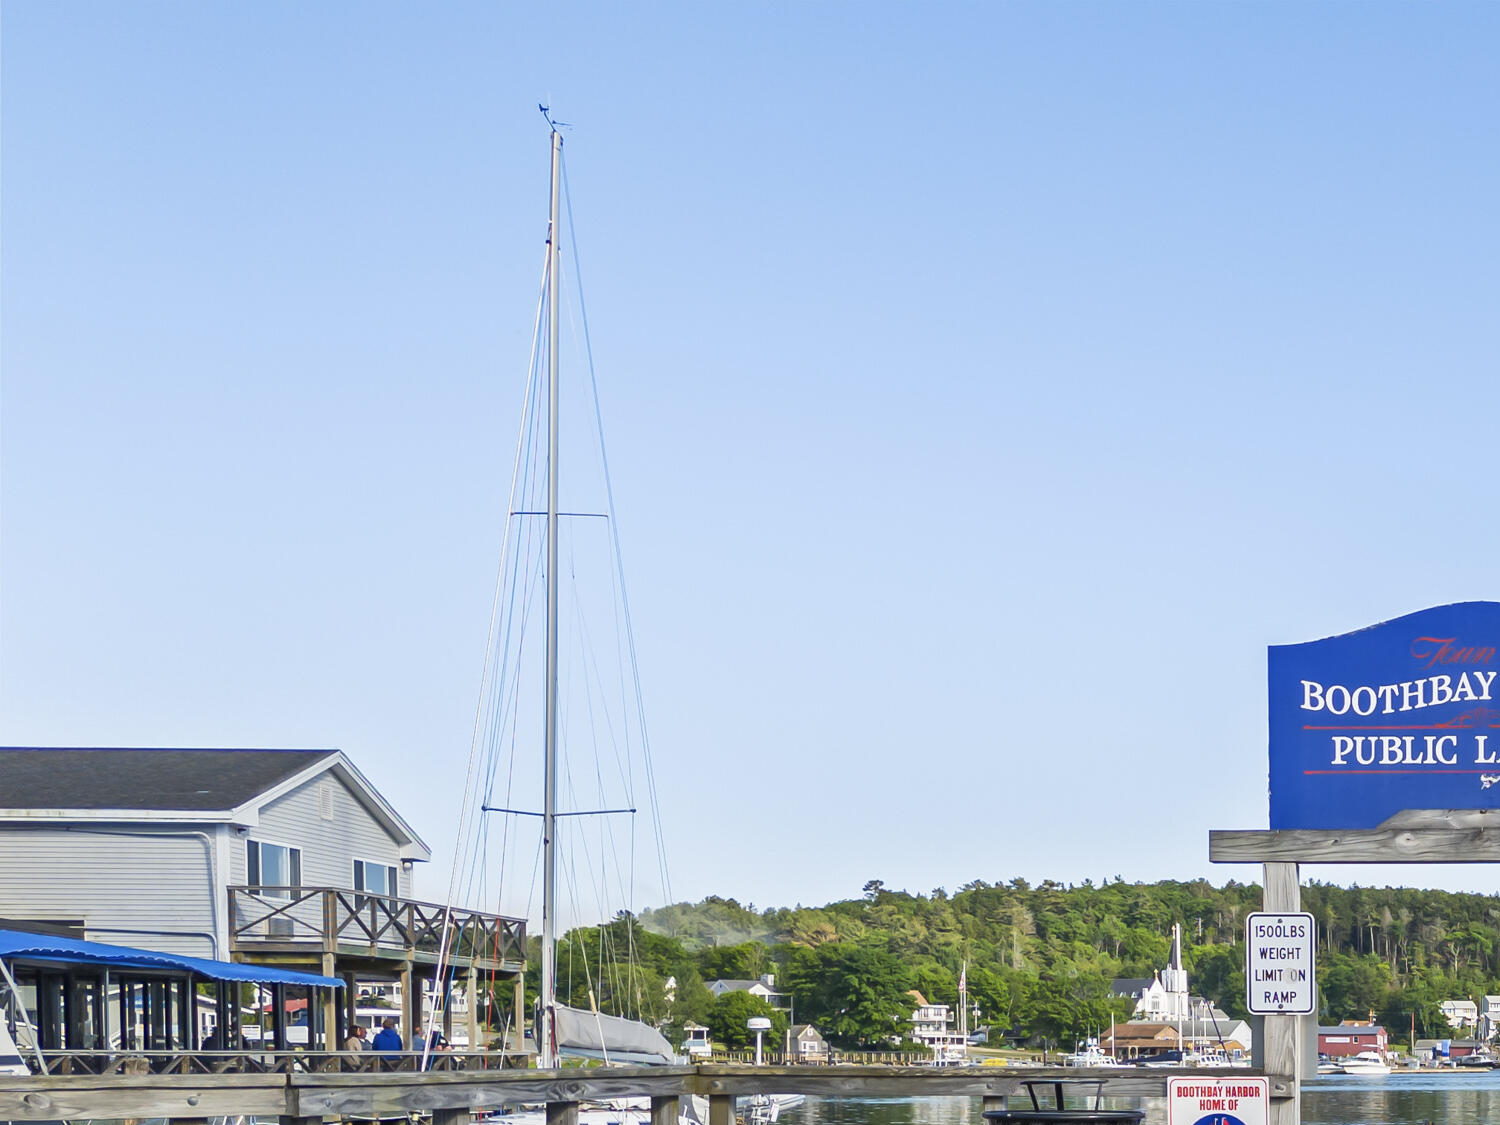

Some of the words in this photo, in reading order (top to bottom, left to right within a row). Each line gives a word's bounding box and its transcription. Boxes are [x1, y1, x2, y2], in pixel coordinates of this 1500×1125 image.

[1410, 636, 1496, 671] Town
[1300, 671, 1497, 716] BOOTHBAY
[1330, 735, 1458, 765] PUBLIC
[1255, 925, 1305, 938] 1500LBS
[1259, 947, 1301, 960] WEIGHT
[1255, 969, 1284, 982] LIMIT
[1290, 968, 1306, 982] ON
[1264, 991, 1297, 1003] RAMP
[1176, 1086, 1223, 1098] BOOTHBAY
[1225, 1086, 1260, 1098] HARBOR
[1199, 1099, 1226, 1111] HOME
[1228, 1099, 1239, 1111] OF
